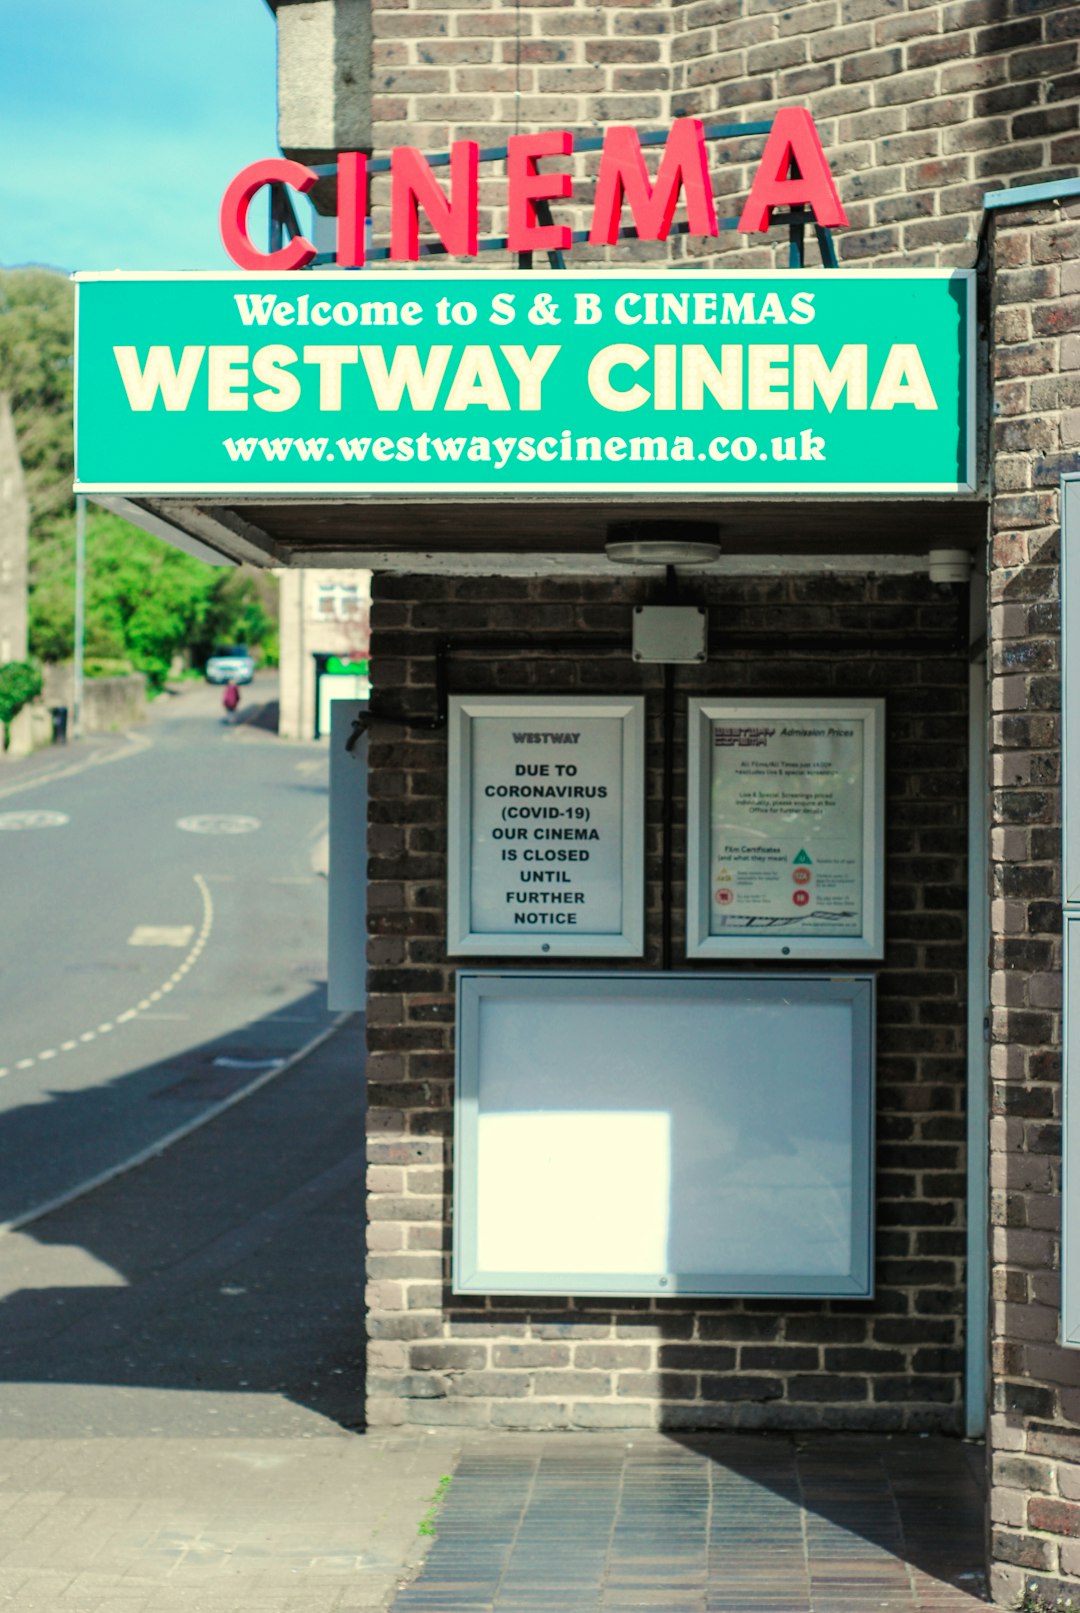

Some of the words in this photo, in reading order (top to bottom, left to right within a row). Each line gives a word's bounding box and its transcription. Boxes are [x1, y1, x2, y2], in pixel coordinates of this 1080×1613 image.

[220, 107, 850, 270] CINEMA
[233, 292, 423, 327] Welcome
[435, 296, 477, 326] to
[489, 293, 516, 326] S
[527, 292, 562, 326] &
[574, 293, 603, 326] B
[614, 291, 816, 327] CINEMAS
[112, 344, 562, 413] WESTWAY
[587, 343, 938, 413] CINEMA
[222, 428, 826, 469] www.westwayscinema.co.uk
[512, 732, 581, 744] WESTWAY
[780, 728, 825, 737] Admission
[827, 728, 854, 737] Prices
[515, 764, 550, 777] DUE
[554, 764, 578, 777] TO
[484, 785, 608, 798] CORONAVIRUS
[501, 806, 591, 822] (COVID-19)
[491, 828, 528, 840] OUR
[533, 828, 600, 840] CINEMA
[501, 849, 518, 861] IS
[523, 849, 590, 862] CLOSED
[741, 846, 781, 854] Certificates
[751, 855, 766, 863] they
[520, 870, 572, 883] UNTIL
[506, 892, 586, 904] FURTHER
[514, 912, 578, 925] NOTICE
